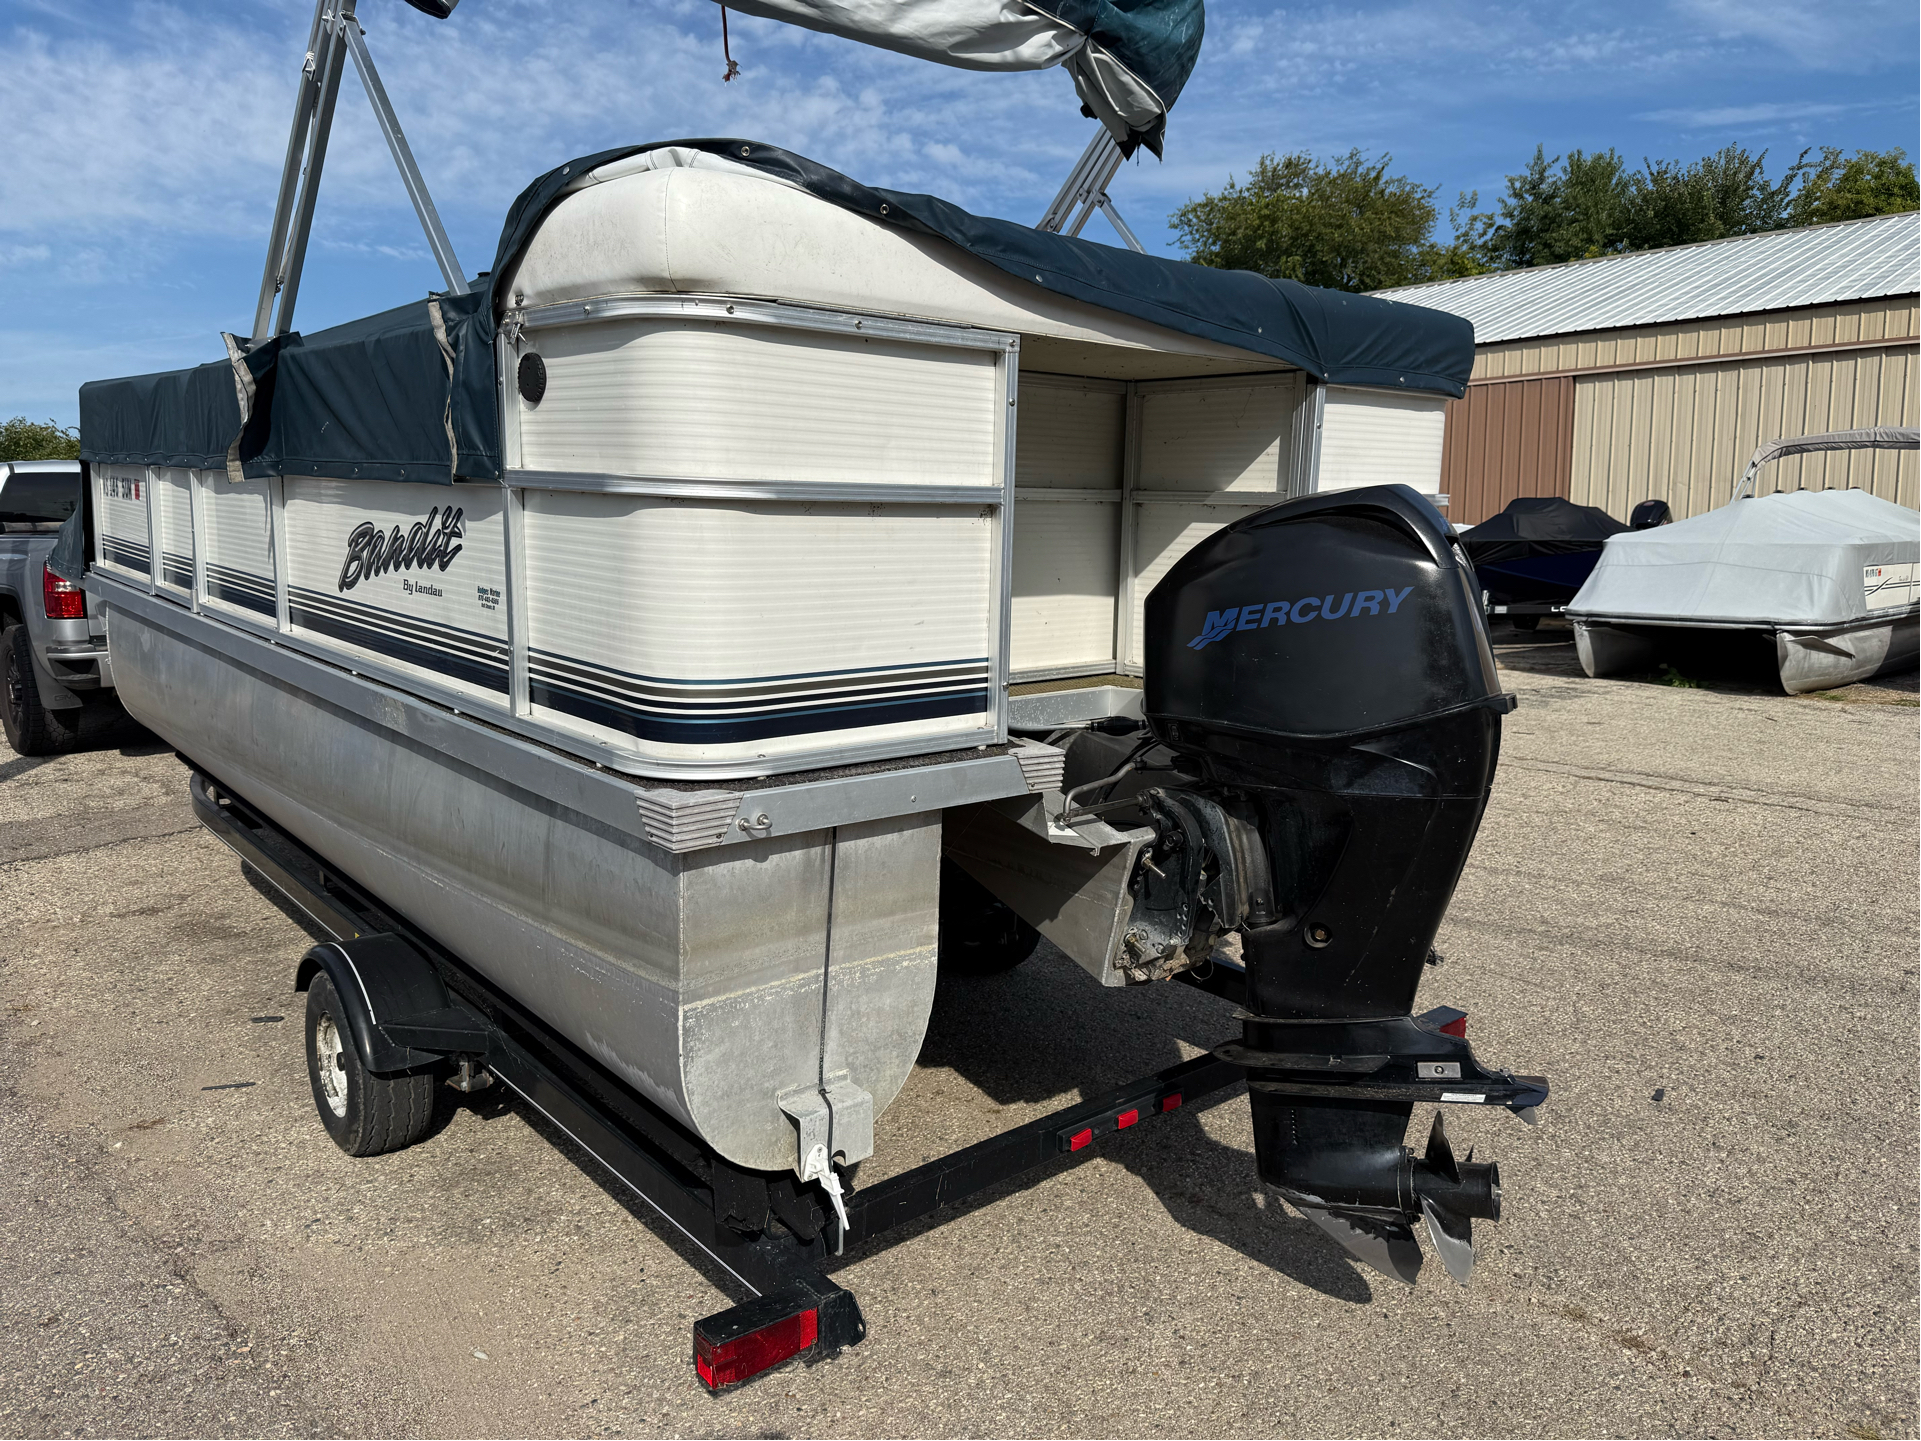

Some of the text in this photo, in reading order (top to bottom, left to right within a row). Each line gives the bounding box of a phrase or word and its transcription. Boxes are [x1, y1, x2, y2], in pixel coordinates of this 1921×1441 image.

[338, 505, 464, 593] Bandit
[403, 579, 414, 596] By
[1187, 586, 1415, 650] MERCURY
